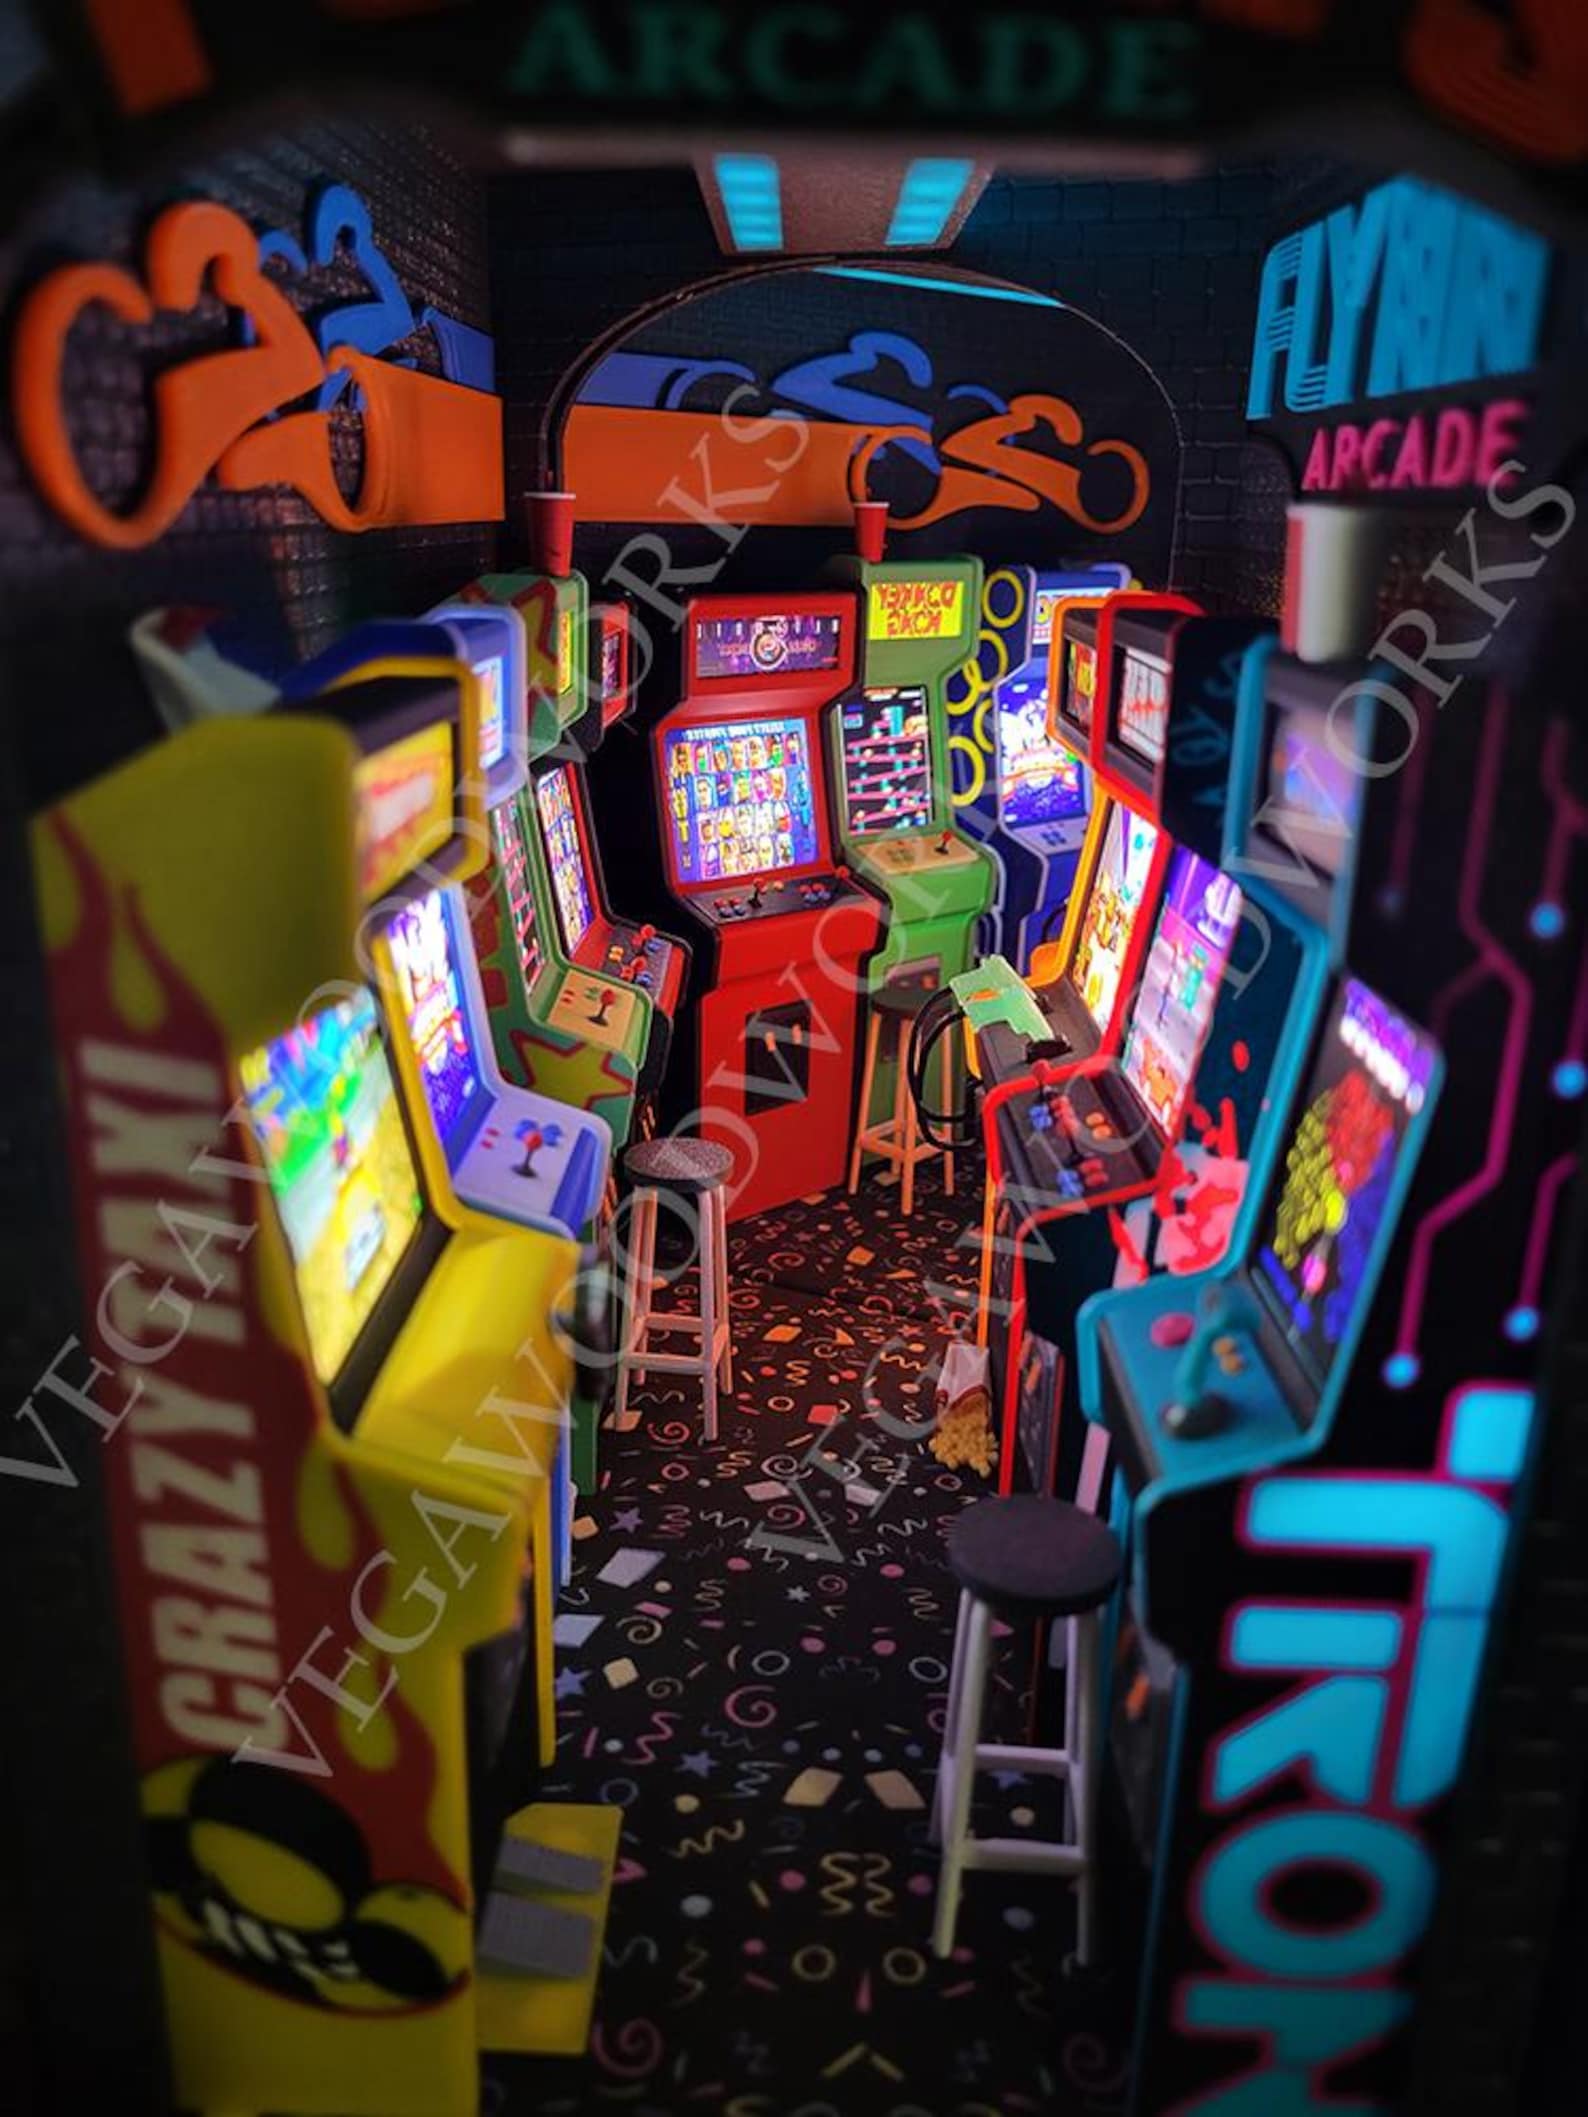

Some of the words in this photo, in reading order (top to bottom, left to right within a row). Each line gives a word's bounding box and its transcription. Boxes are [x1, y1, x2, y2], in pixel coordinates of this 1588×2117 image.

[503, 0, 1199, 118] ARCADE
[1300, 399, 1531, 491] ARCADE
[77, 1037, 249, 1348] TAXI
[116, 1364, 292, 1755] CRAZY
